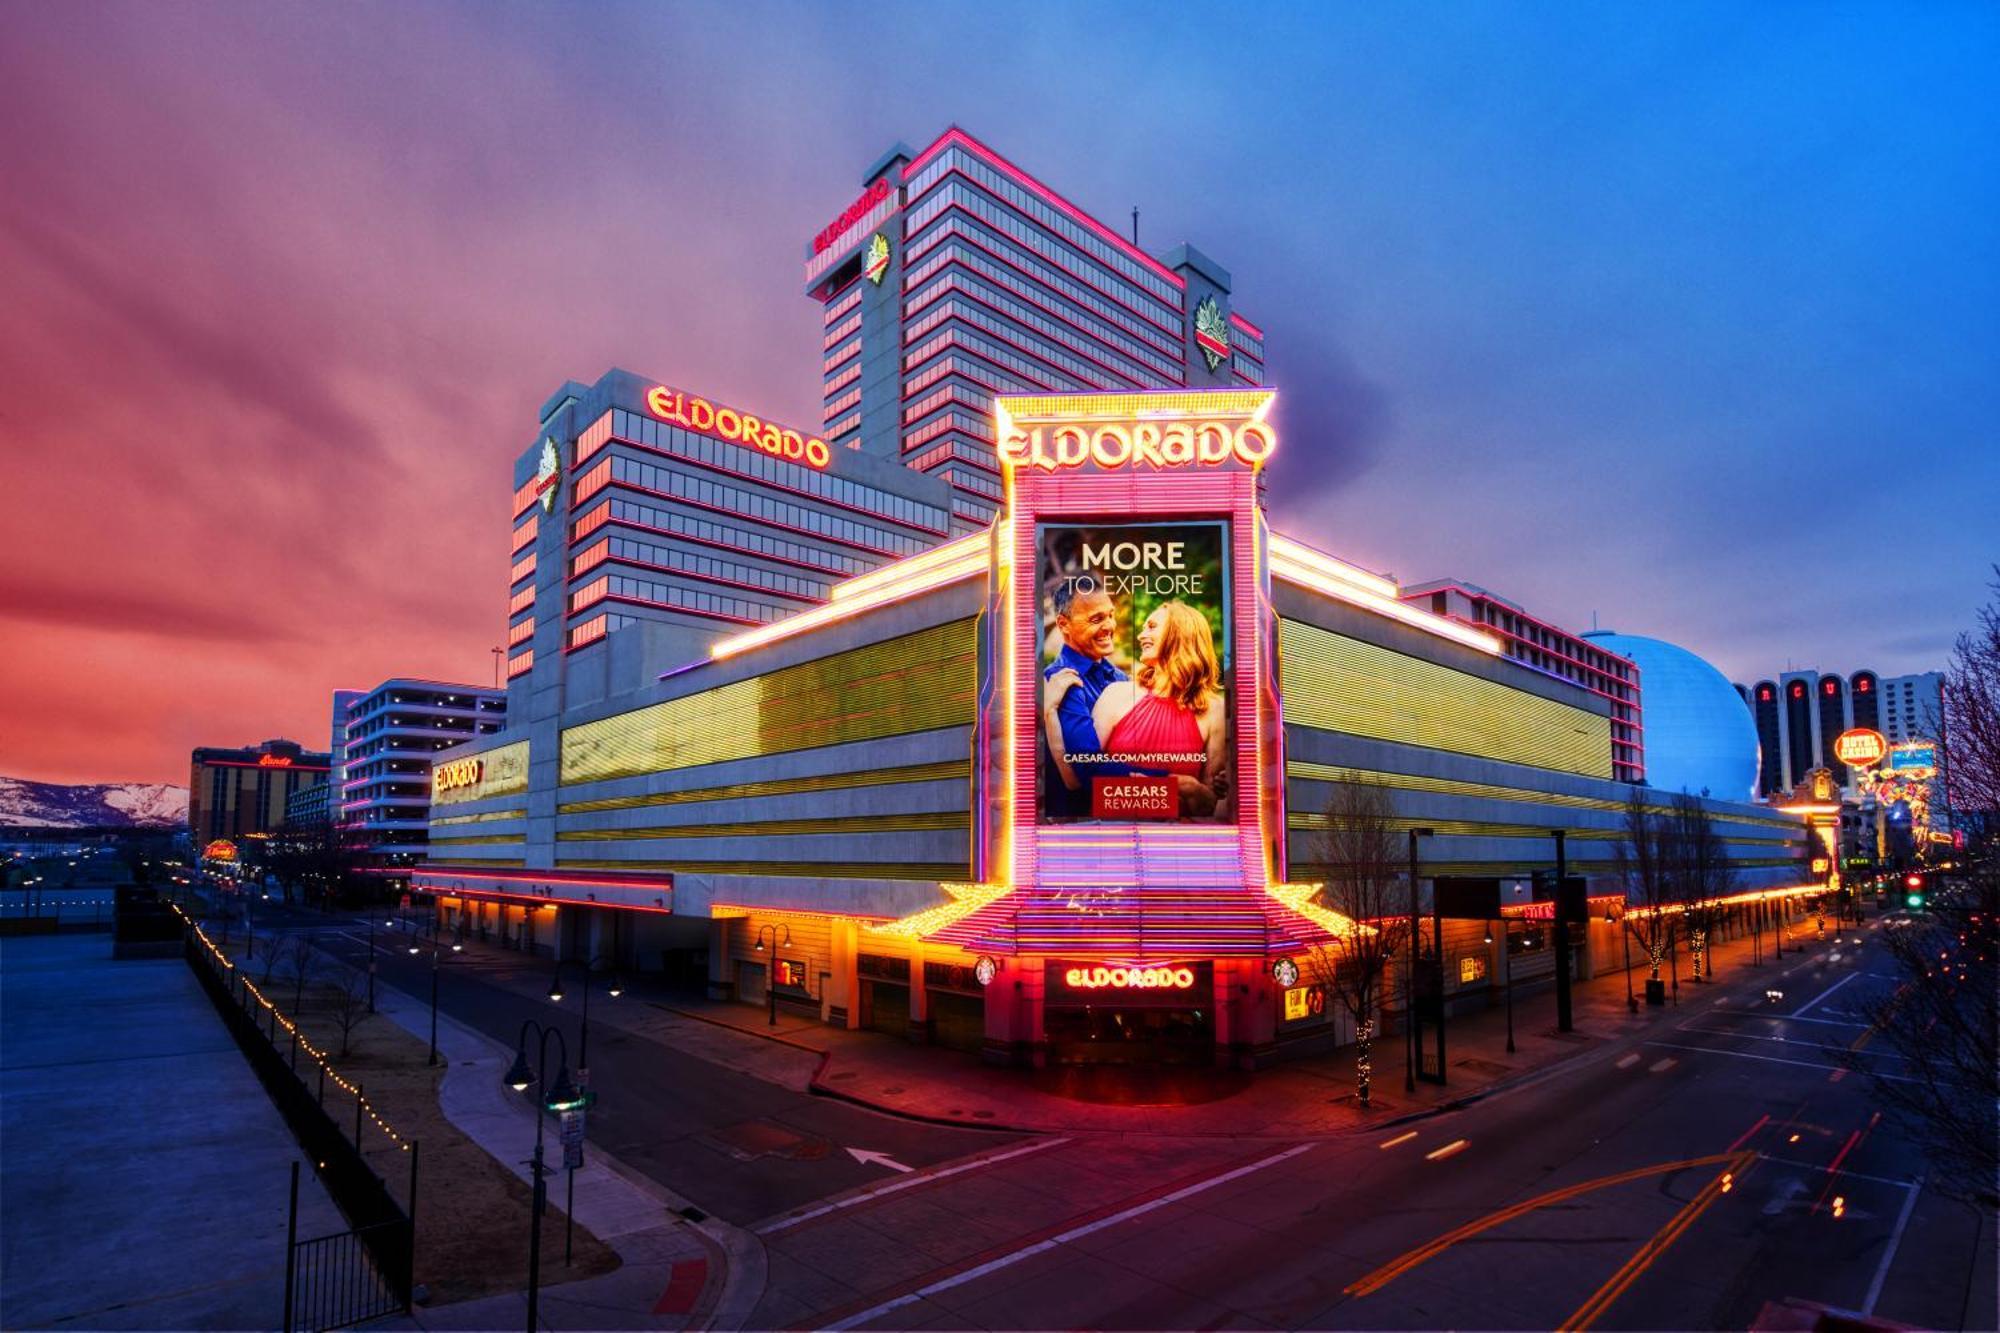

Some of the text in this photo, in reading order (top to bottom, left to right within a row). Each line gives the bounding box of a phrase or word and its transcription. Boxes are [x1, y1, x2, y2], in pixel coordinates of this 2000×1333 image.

[647, 386, 831, 468] ELDORADO
[998, 421, 1276, 474] ELDORADO
[1082, 541, 1185, 570] MORE
[1064, 574, 1203, 596] TO EXPLORE
[1842, 735, 1878, 748] HOTEL
[1063, 752, 1207, 764] CAESARS.COM/MYREWARDS
[1841, 746, 1880, 759] CASINO
[1103, 785, 1168, 797] CAESARS
